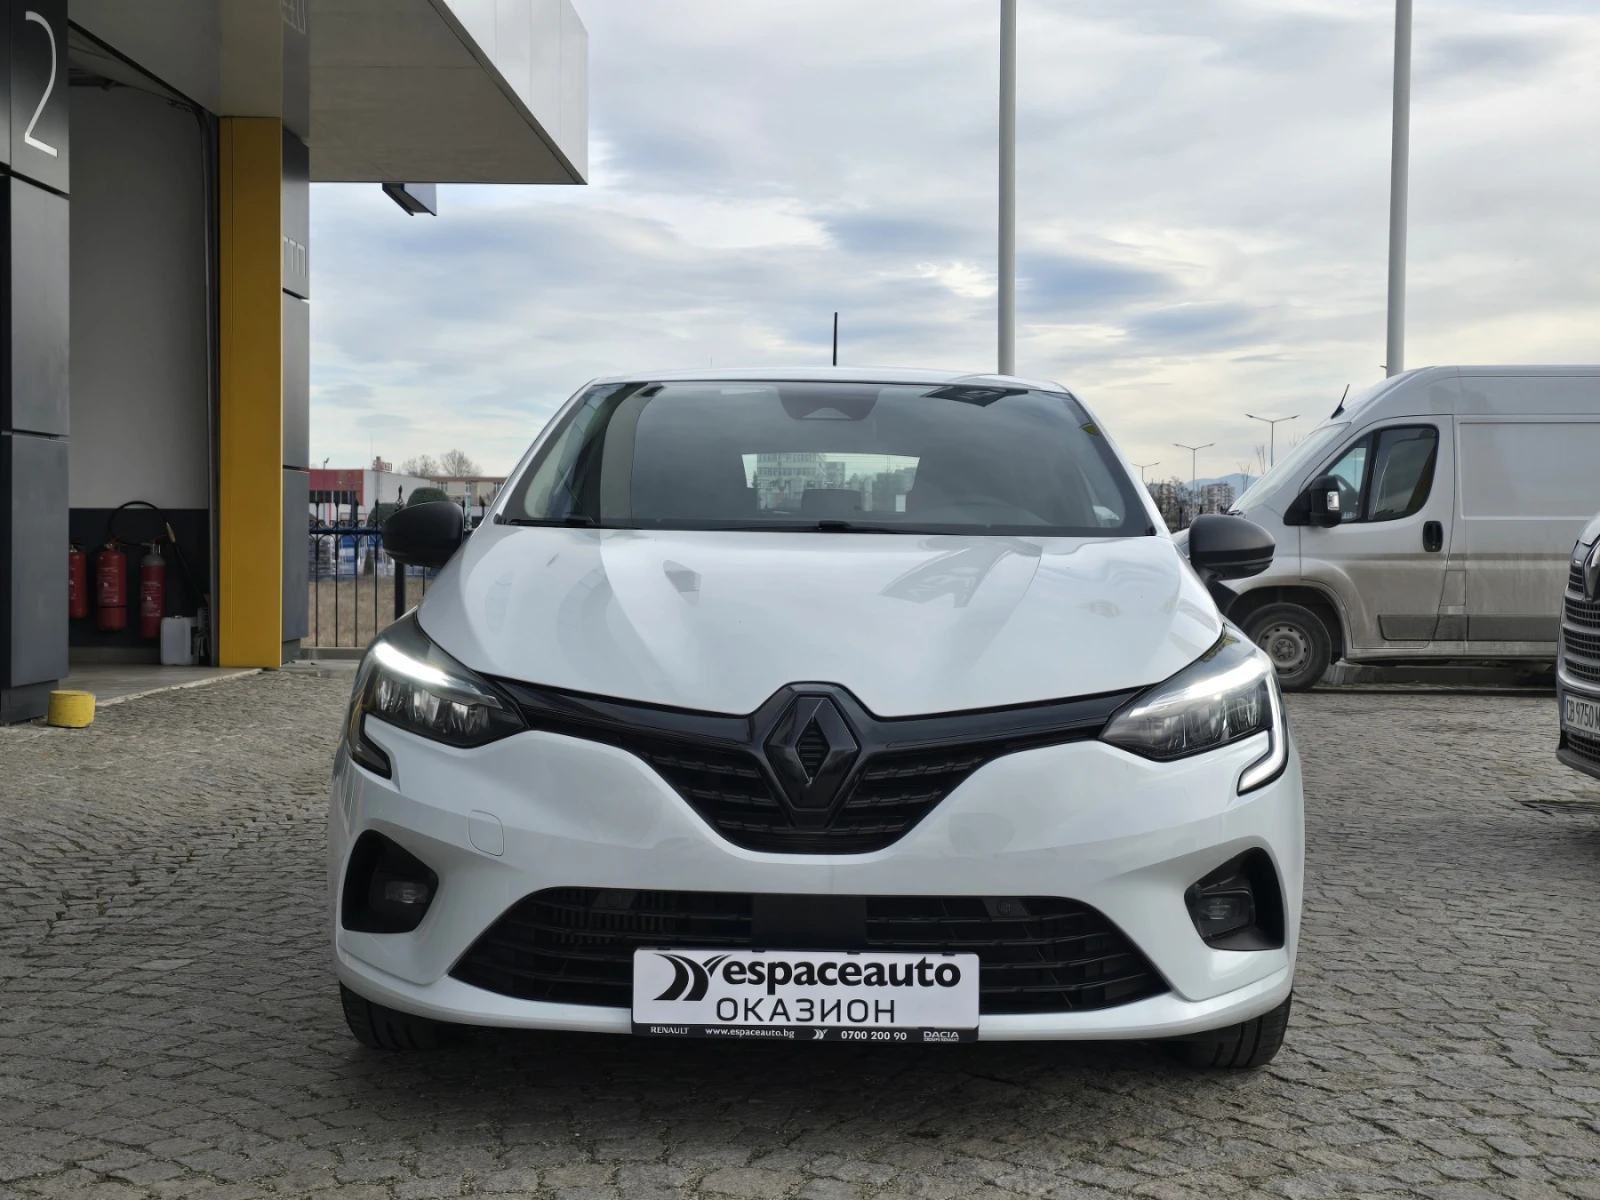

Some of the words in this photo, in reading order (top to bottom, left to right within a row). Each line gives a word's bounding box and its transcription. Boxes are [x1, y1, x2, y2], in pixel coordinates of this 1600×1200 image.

[25, 11, 57, 158] 2
[722, 956, 961, 996] espaceauto
[716, 997, 895, 1024] ОКАЗИОН
[650, 1026, 690, 1035] RENAULT
[705, 1028, 795, 1039] www.espaceauto.bg
[841, 1030, 868, 1040] 0700
[870, 1031, 891, 1041] 200
[893, 1031, 908, 1041] 90
